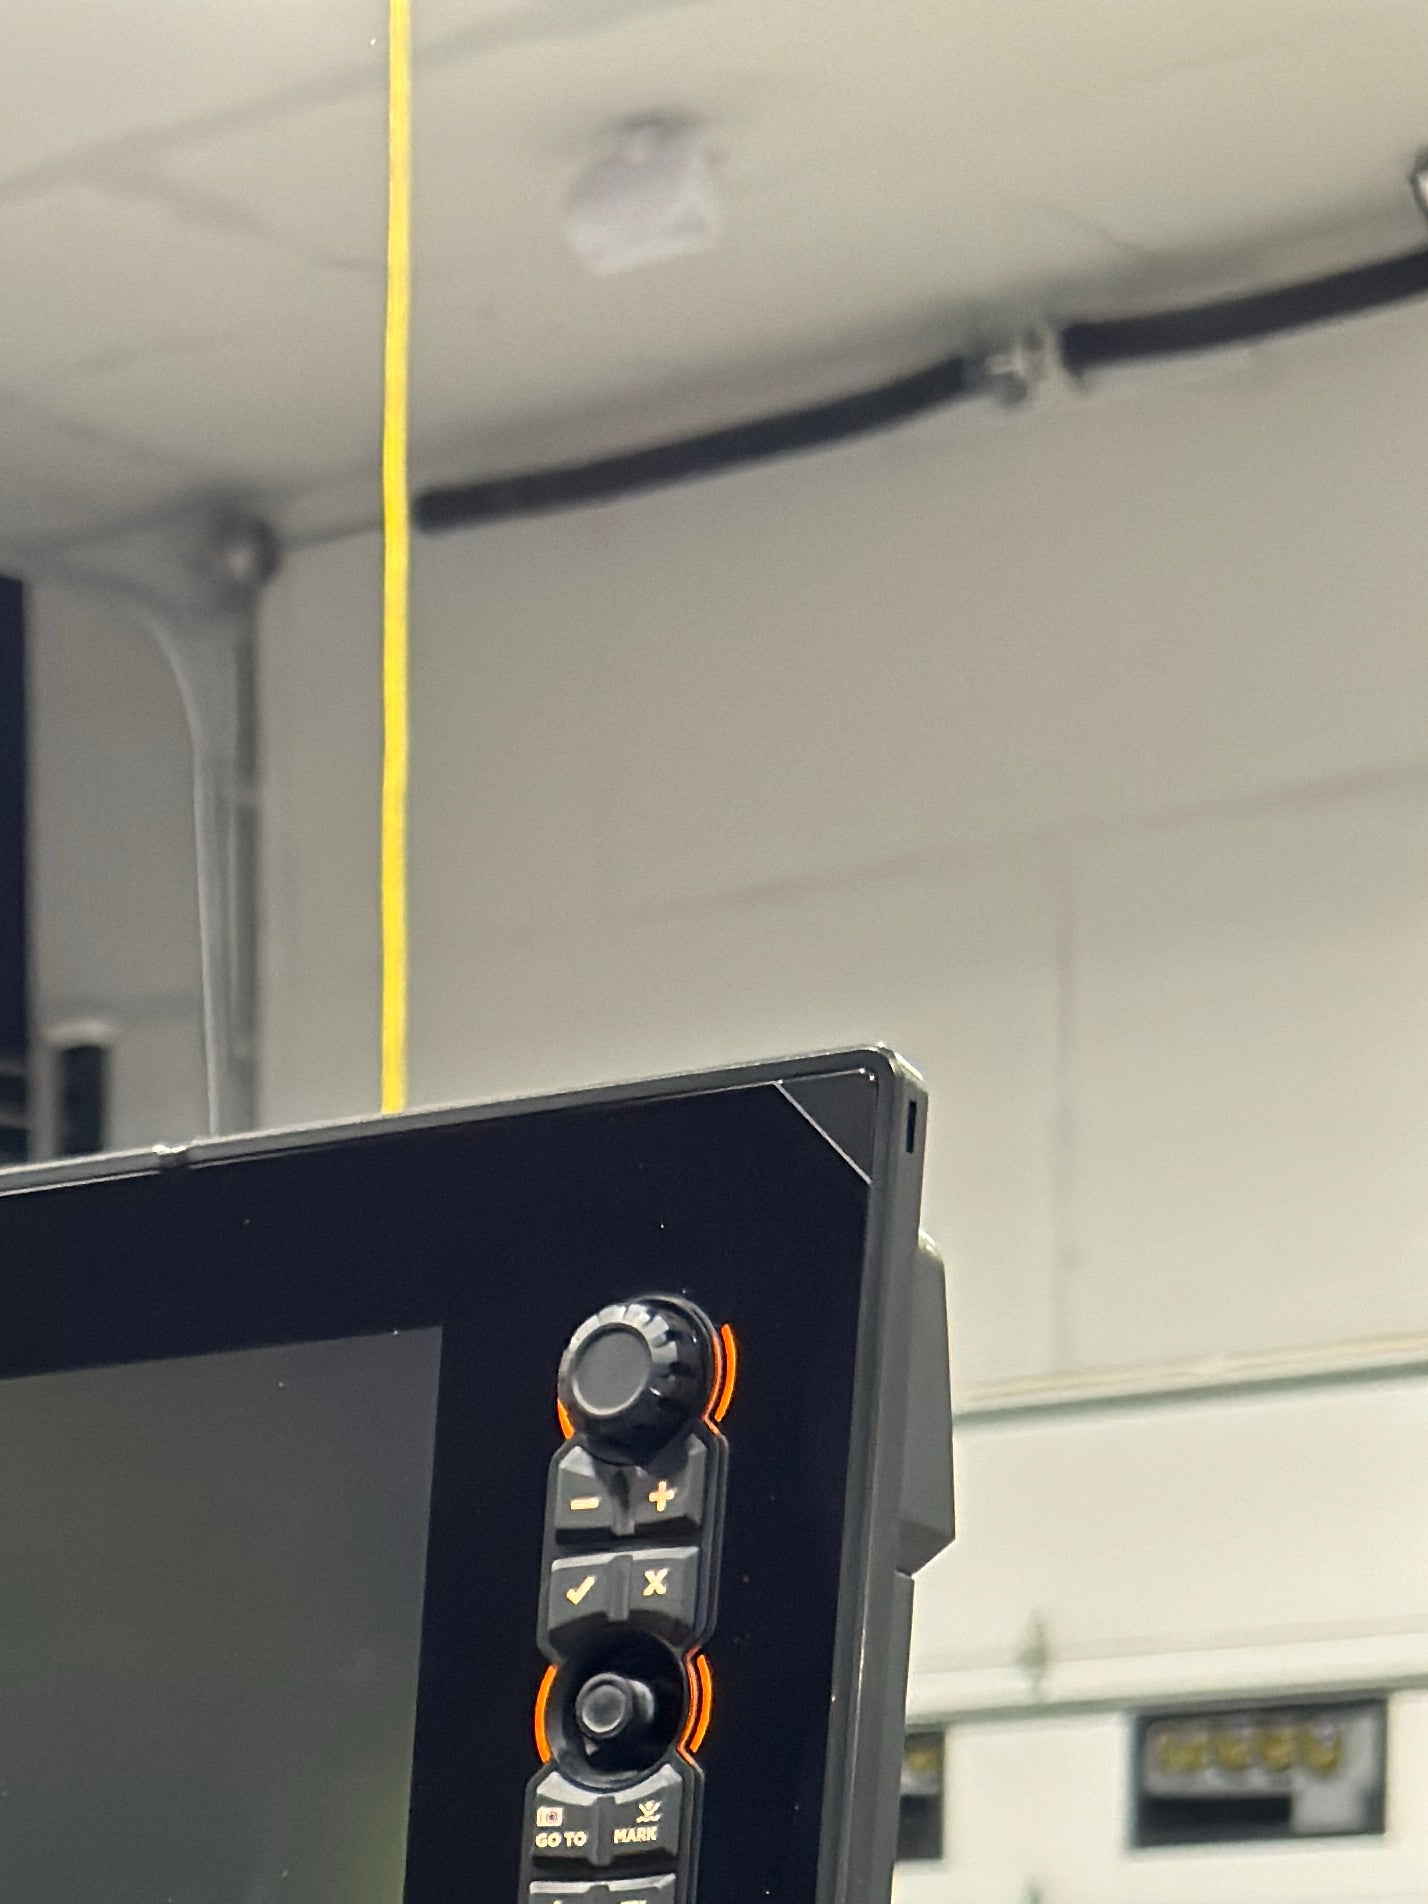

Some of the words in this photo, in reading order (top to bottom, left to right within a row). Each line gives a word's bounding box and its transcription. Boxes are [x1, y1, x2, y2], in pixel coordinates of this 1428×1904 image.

[535, 1832, 561, 1848] GO
[564, 1831, 587, 1847] TO
[614, 1826, 657, 1844] MARK
